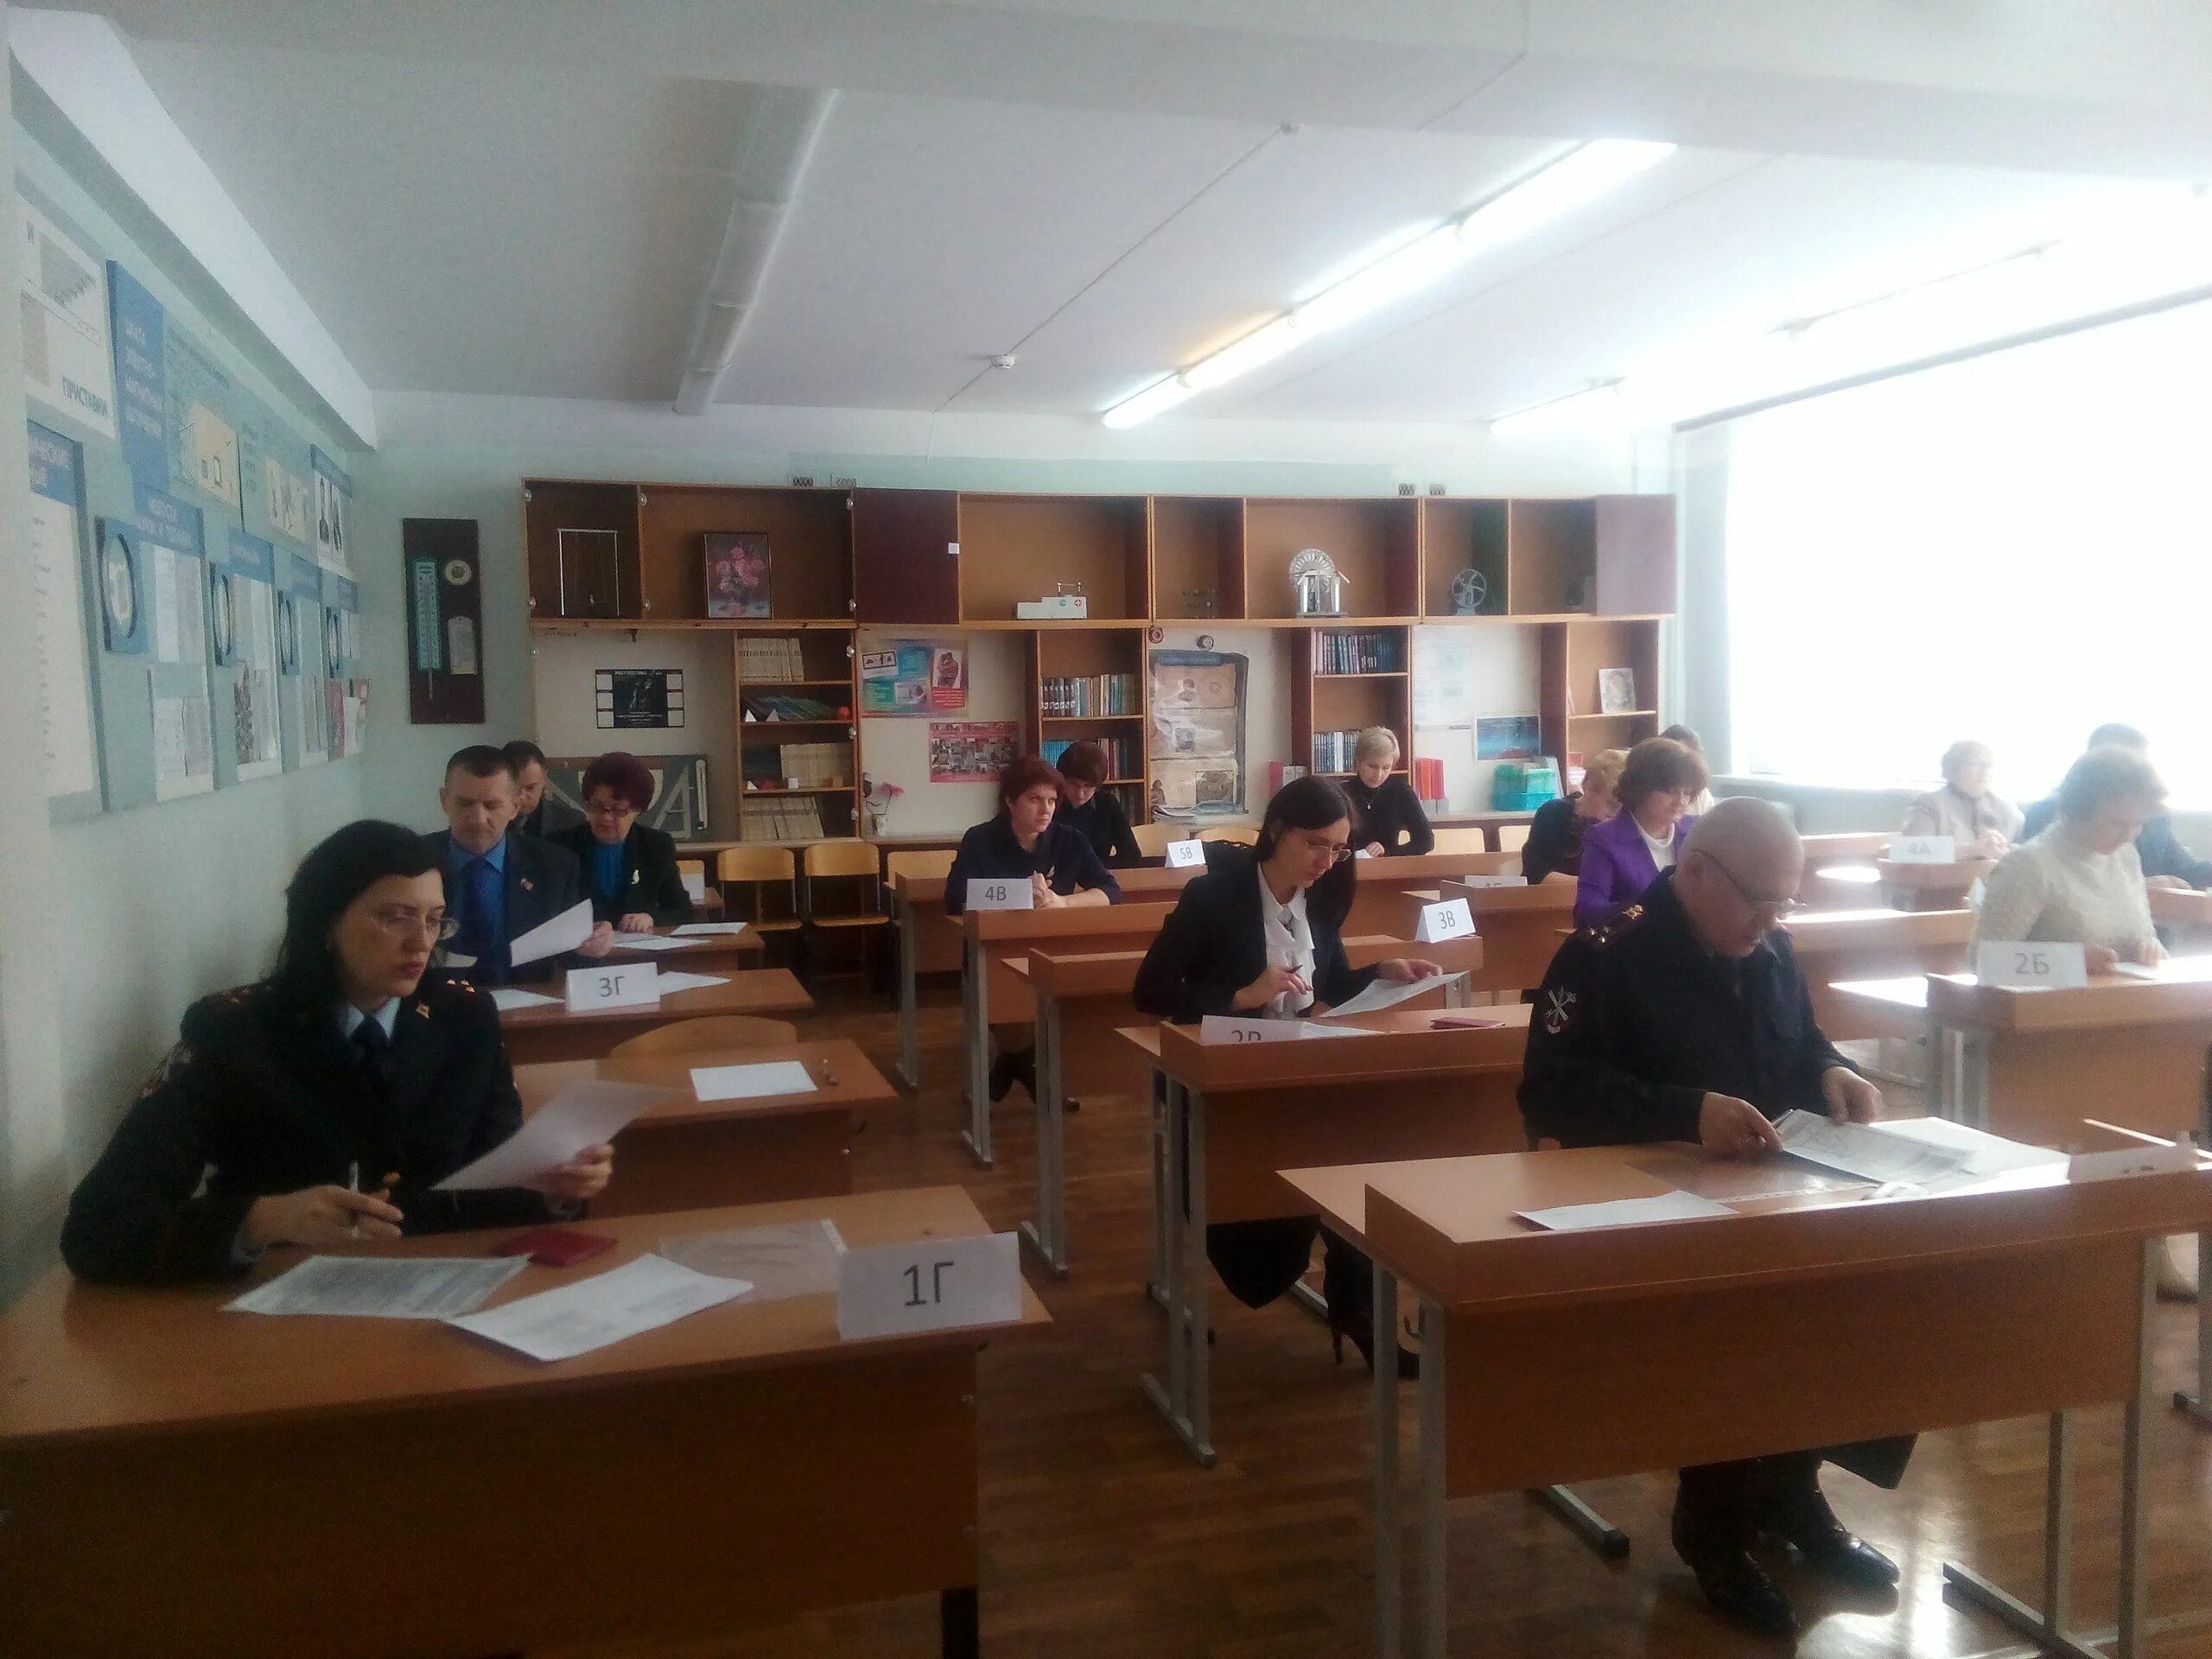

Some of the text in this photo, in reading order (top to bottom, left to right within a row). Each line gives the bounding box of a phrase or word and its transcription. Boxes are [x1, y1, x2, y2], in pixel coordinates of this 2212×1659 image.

[1180, 846, 1193, 861] 5В
[985, 886, 1007, 901] 4В
[1438, 910, 1456, 930] 3В
[2014, 952, 2050, 976] 2Б
[598, 975, 626, 998] 3Г
[903, 1261, 955, 1307] 1Г
